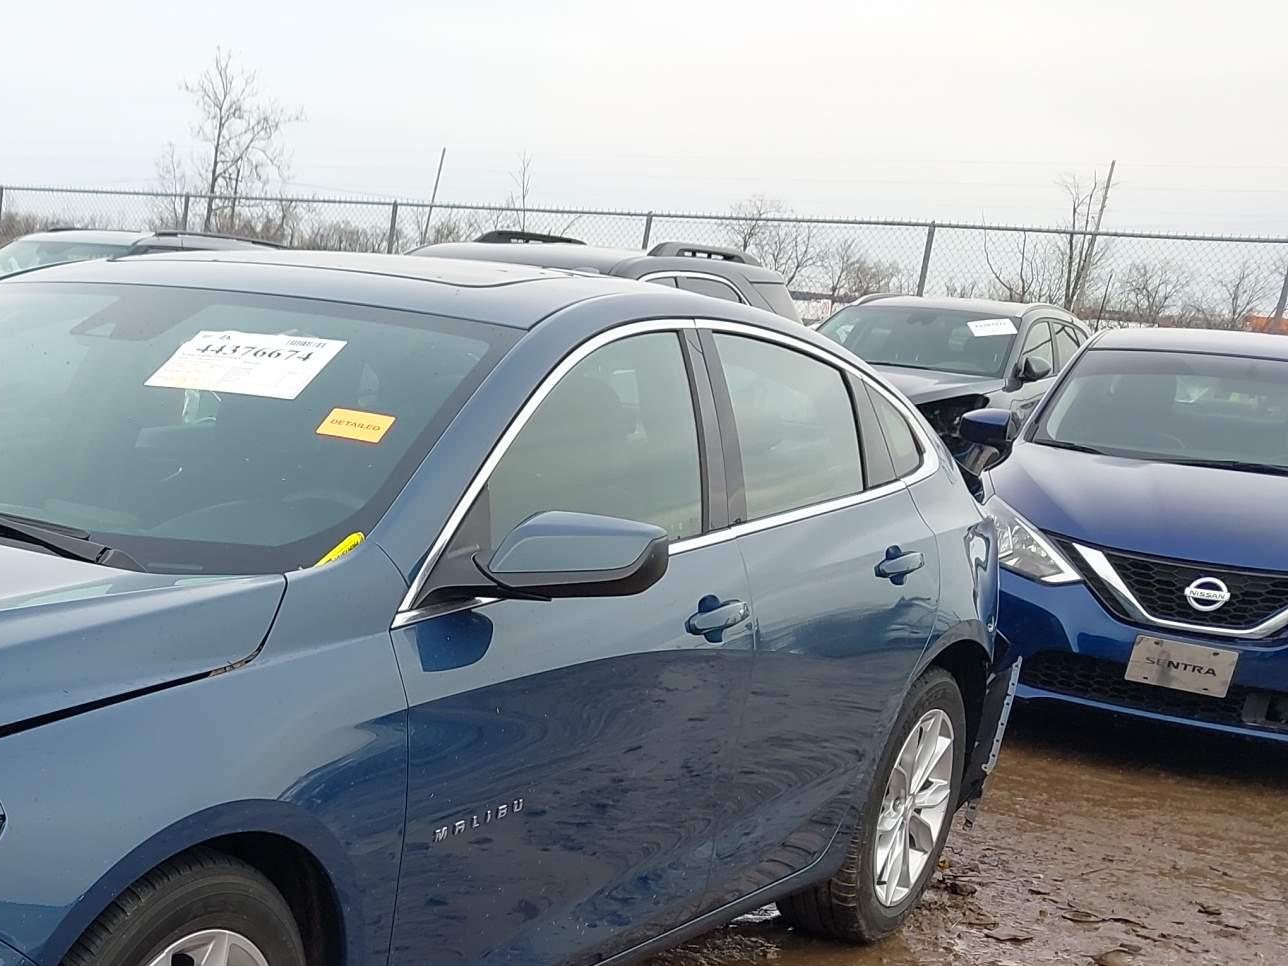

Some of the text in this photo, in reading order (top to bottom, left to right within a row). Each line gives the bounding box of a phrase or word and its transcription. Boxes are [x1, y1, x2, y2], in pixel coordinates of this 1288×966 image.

[196, 344, 314, 362] 44376674
[330, 418, 381, 432] DETAILED
[1189, 590, 1225, 599] NISSAN
[1144, 656, 1217, 677] SENTRA
[433, 799, 524, 842] MALIBU
